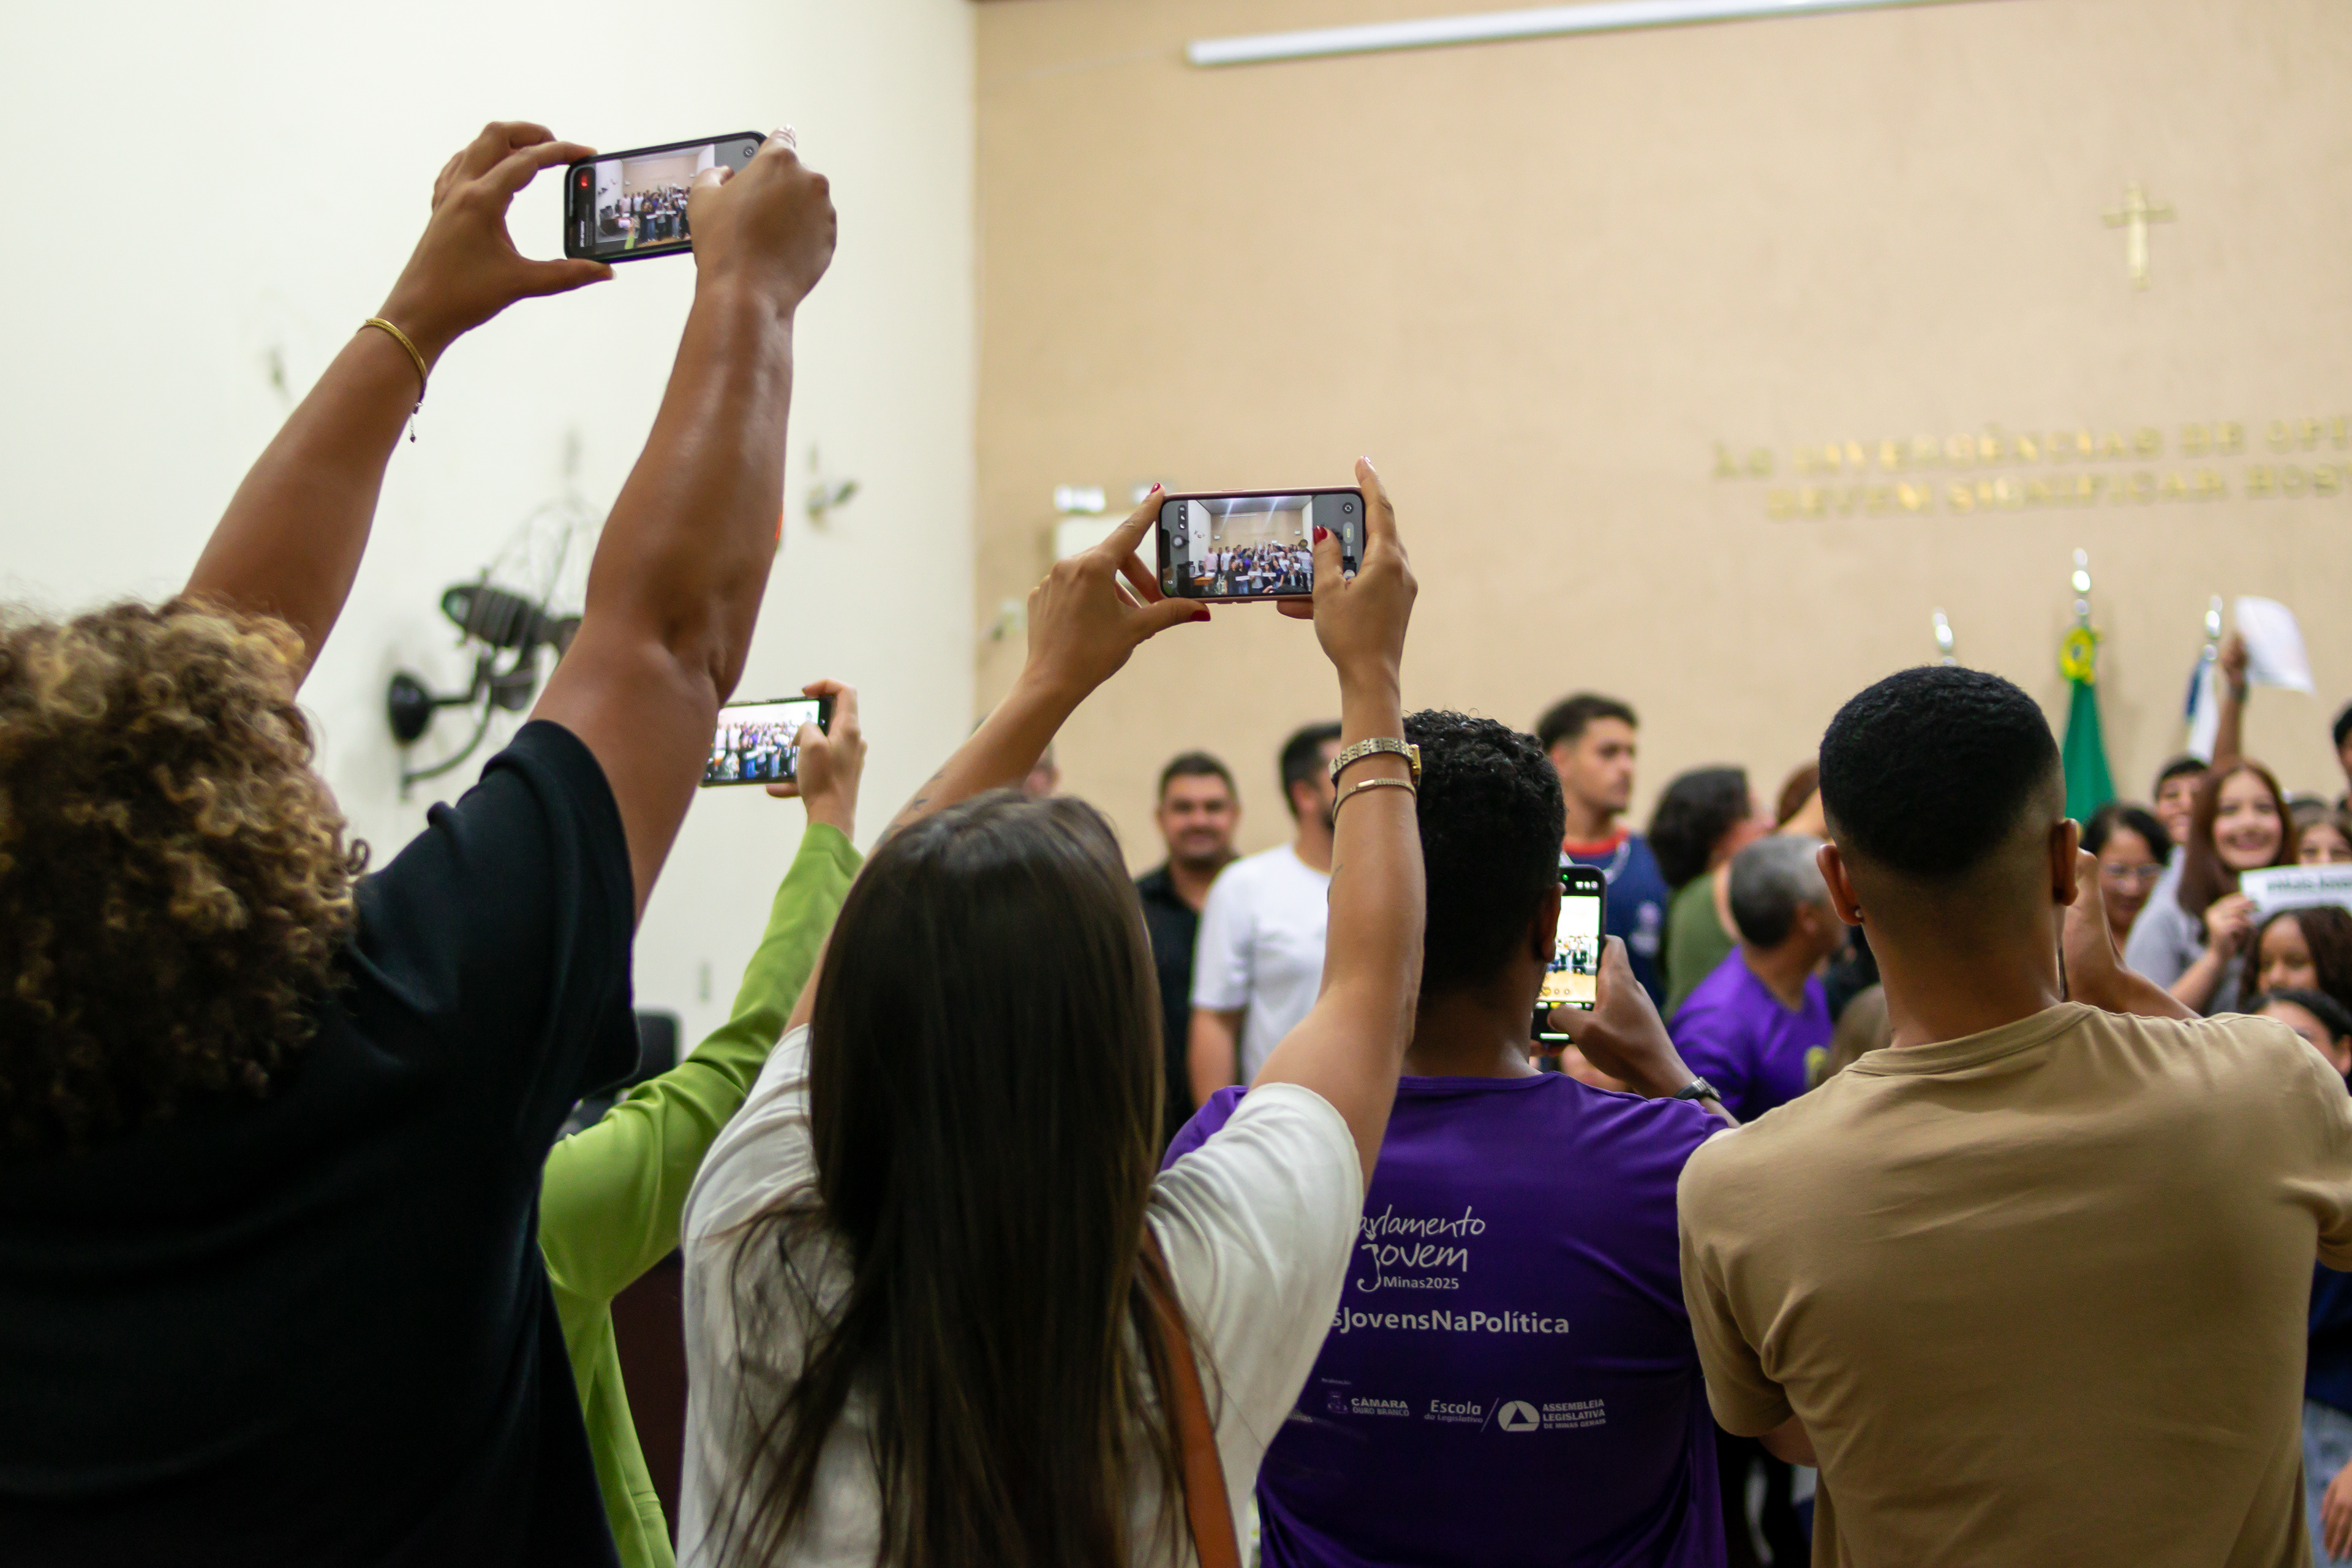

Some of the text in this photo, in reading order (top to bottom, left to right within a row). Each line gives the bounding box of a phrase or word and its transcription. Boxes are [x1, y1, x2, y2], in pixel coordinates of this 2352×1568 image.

[2247, 459, 2352, 499] HOS
[1359, 1204, 1486, 1238] arlamento
[1383, 1275, 1460, 1289] Minas2025
[1332, 1306, 1570, 1333] sJovensNaPolítica
[1351, 1396, 1408, 1409] CÂMARA
[1430, 1400, 1481, 1415] Escola
[1543, 1398, 1605, 1412] ASSEMBLEIA
[1543, 1408, 1605, 1422] LEGISLATIVA
